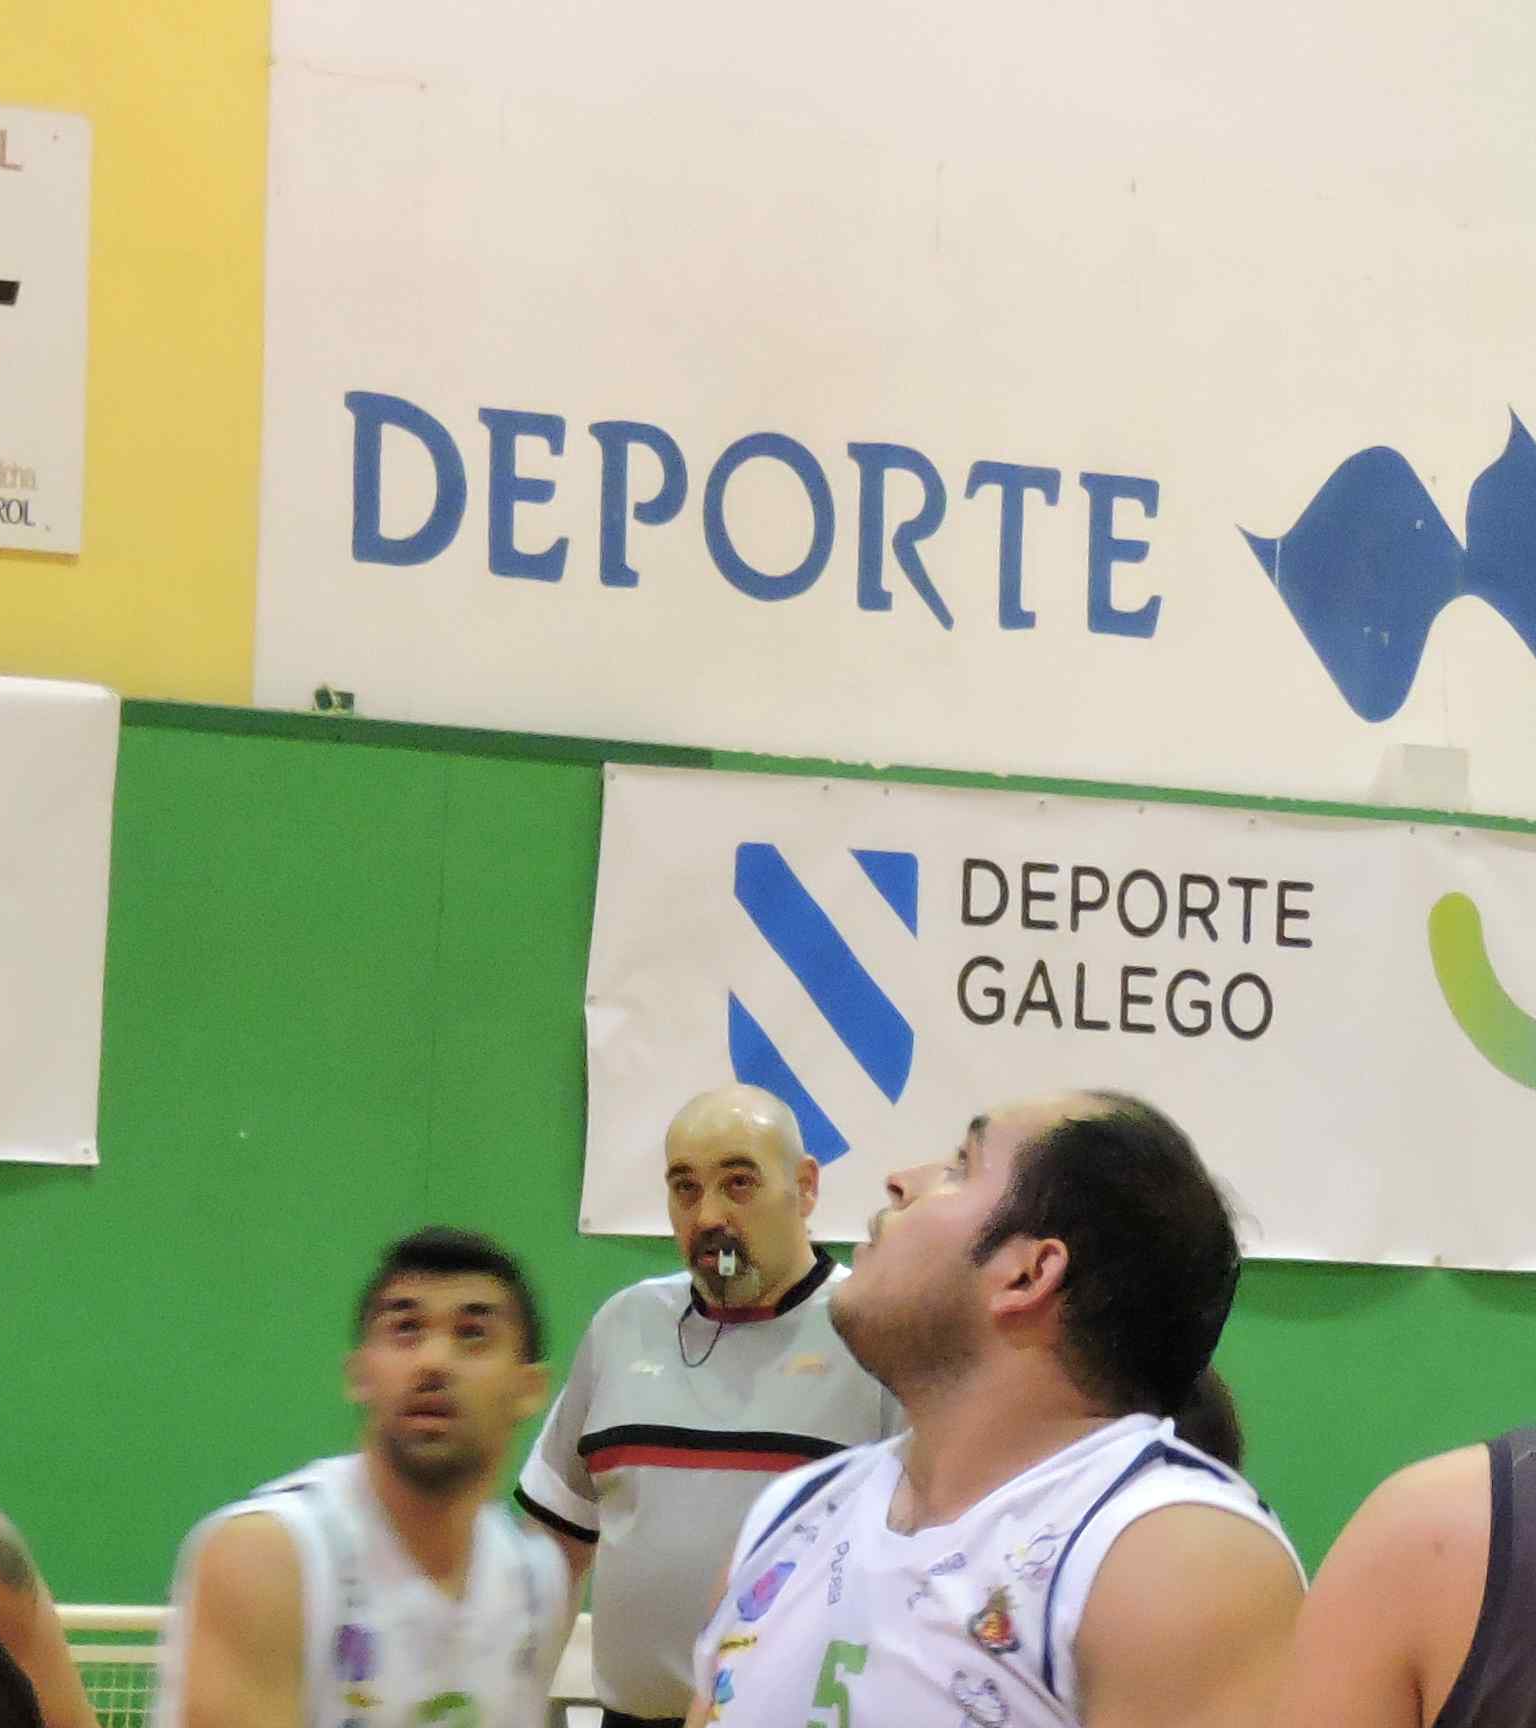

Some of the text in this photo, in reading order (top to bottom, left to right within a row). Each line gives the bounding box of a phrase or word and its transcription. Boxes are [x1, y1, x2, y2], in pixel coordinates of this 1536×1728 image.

[343, 390, 1163, 639] DEPORTE
[961, 857, 1315, 948] DEPORTE
[956, 955, 1273, 1041] GALEGO
